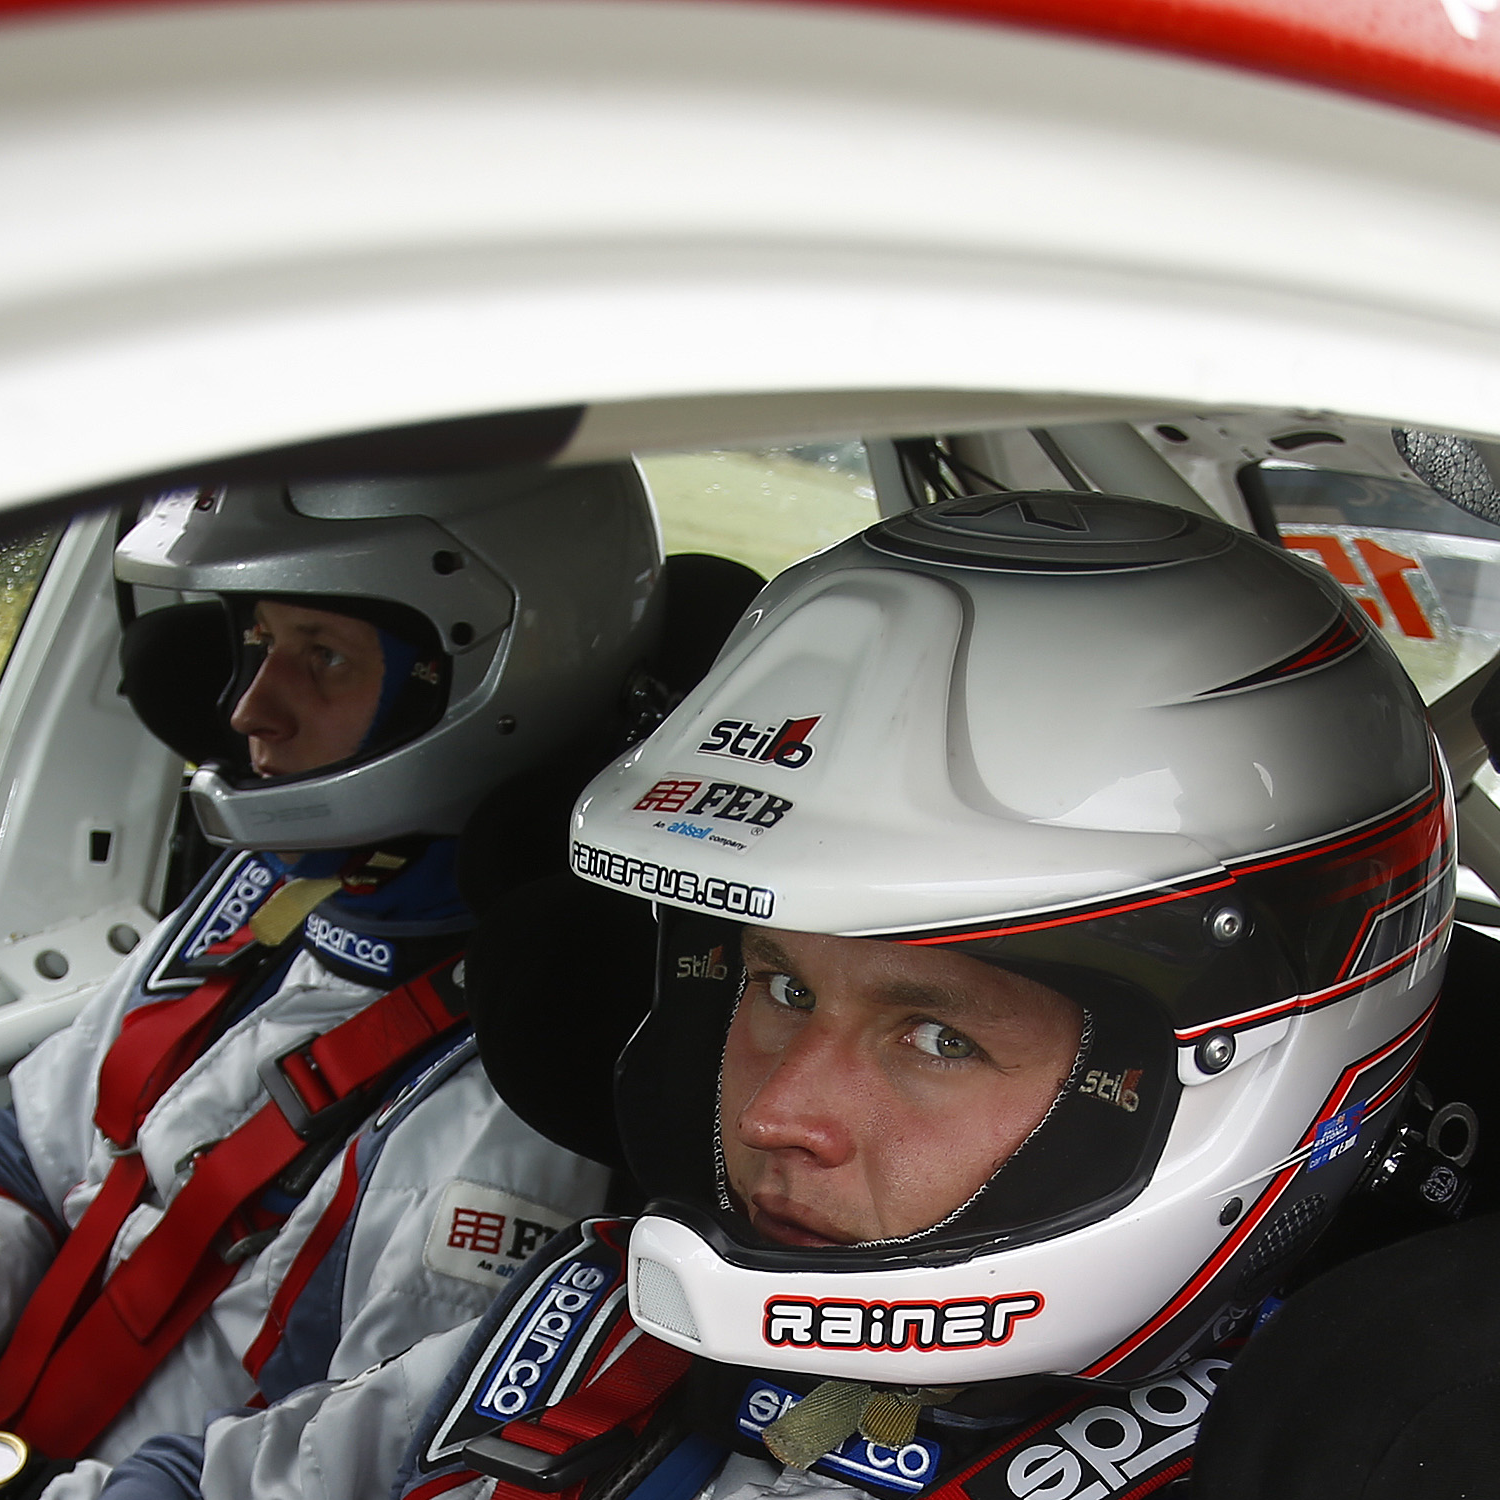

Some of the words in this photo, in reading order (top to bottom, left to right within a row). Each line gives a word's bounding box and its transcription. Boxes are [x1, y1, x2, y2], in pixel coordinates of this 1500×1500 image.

[685, 782, 794, 829] FEB
[667, 820, 712, 840] ahlsell
[708, 833, 747, 851] company
[306, 911, 392, 973] sparco
[481, 1261, 605, 1415] sparco
